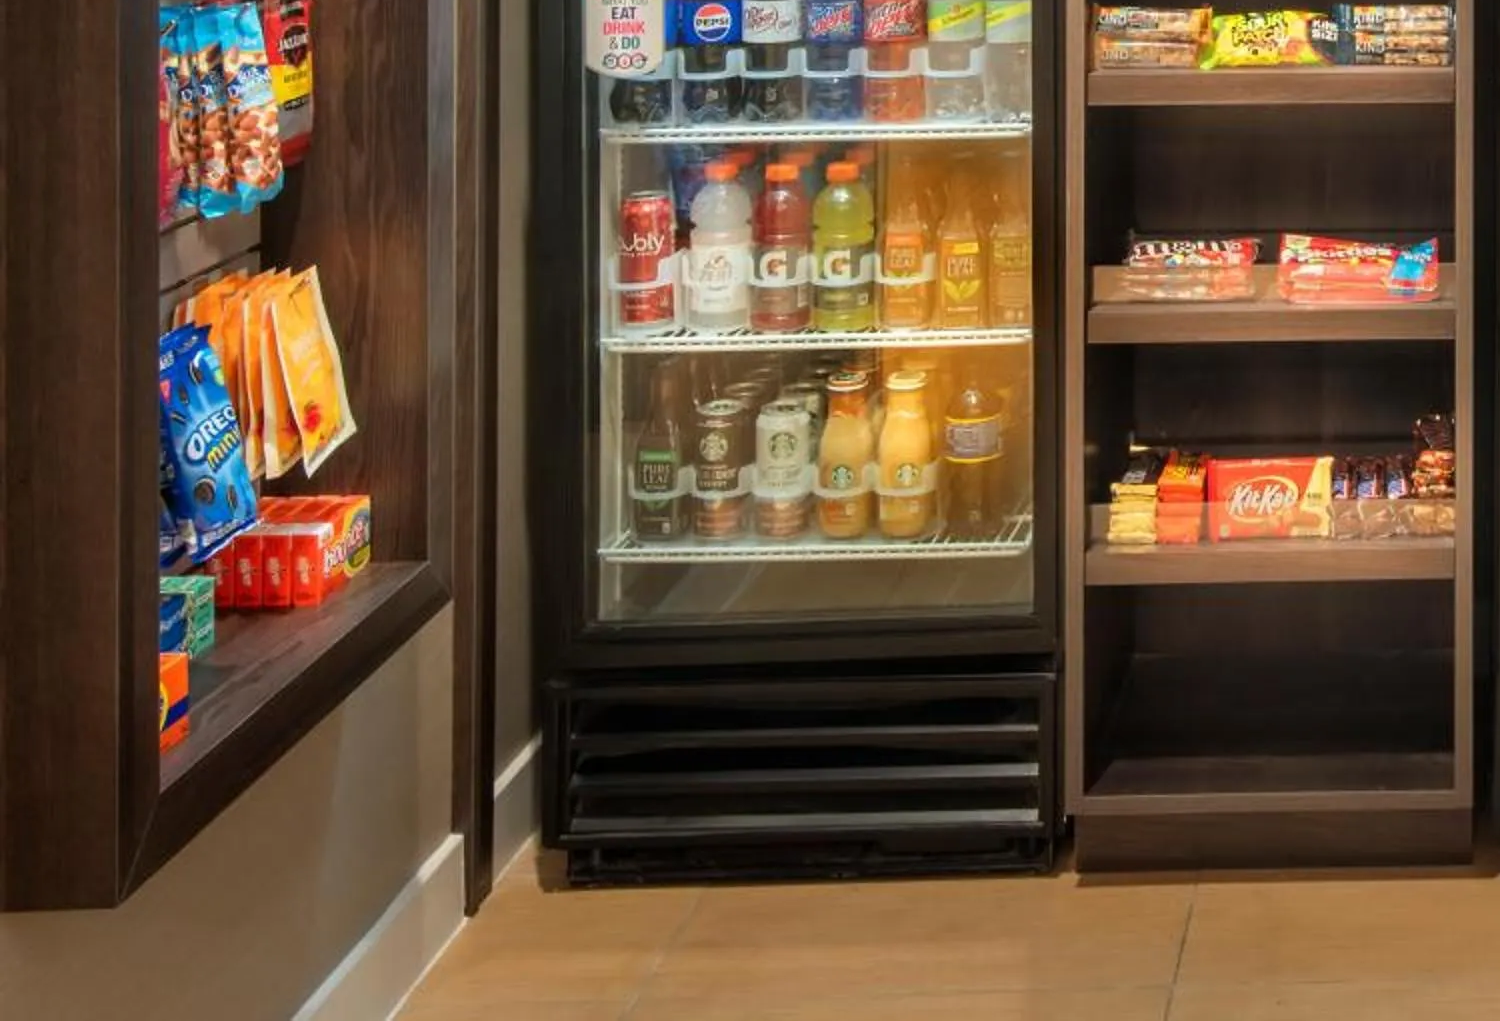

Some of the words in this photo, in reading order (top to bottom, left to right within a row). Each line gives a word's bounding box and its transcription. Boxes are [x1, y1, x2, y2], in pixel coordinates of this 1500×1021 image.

[611, 7, 637, 20] EAT
[603, 21, 645, 36] DRINK
[696, 18, 729, 28] PEPSI
[621, 36, 640, 49] DO
[186, 405, 236, 461] OREO
